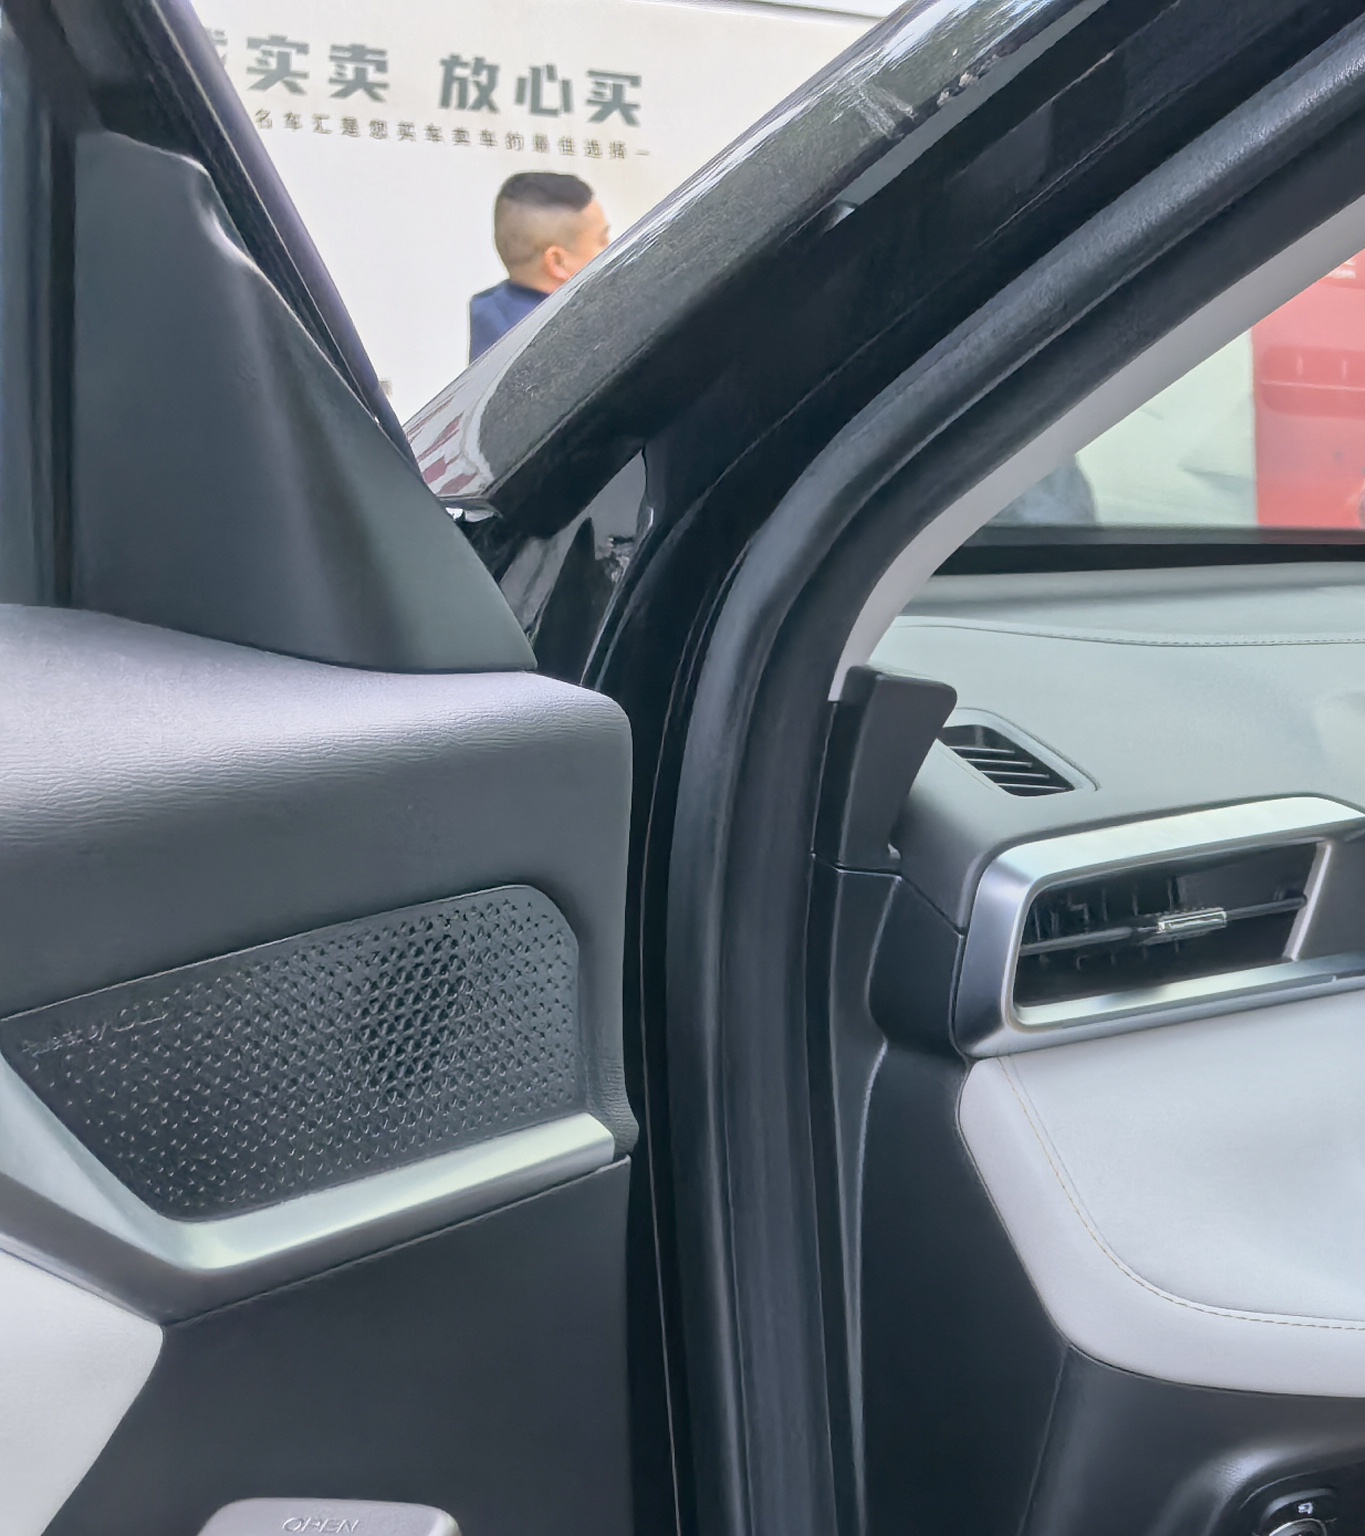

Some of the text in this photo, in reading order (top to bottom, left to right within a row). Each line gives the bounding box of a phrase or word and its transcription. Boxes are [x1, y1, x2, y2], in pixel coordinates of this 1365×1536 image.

[438, 53, 642, 126] 放心买
[282, 1517, 359, 1533] OPEN
